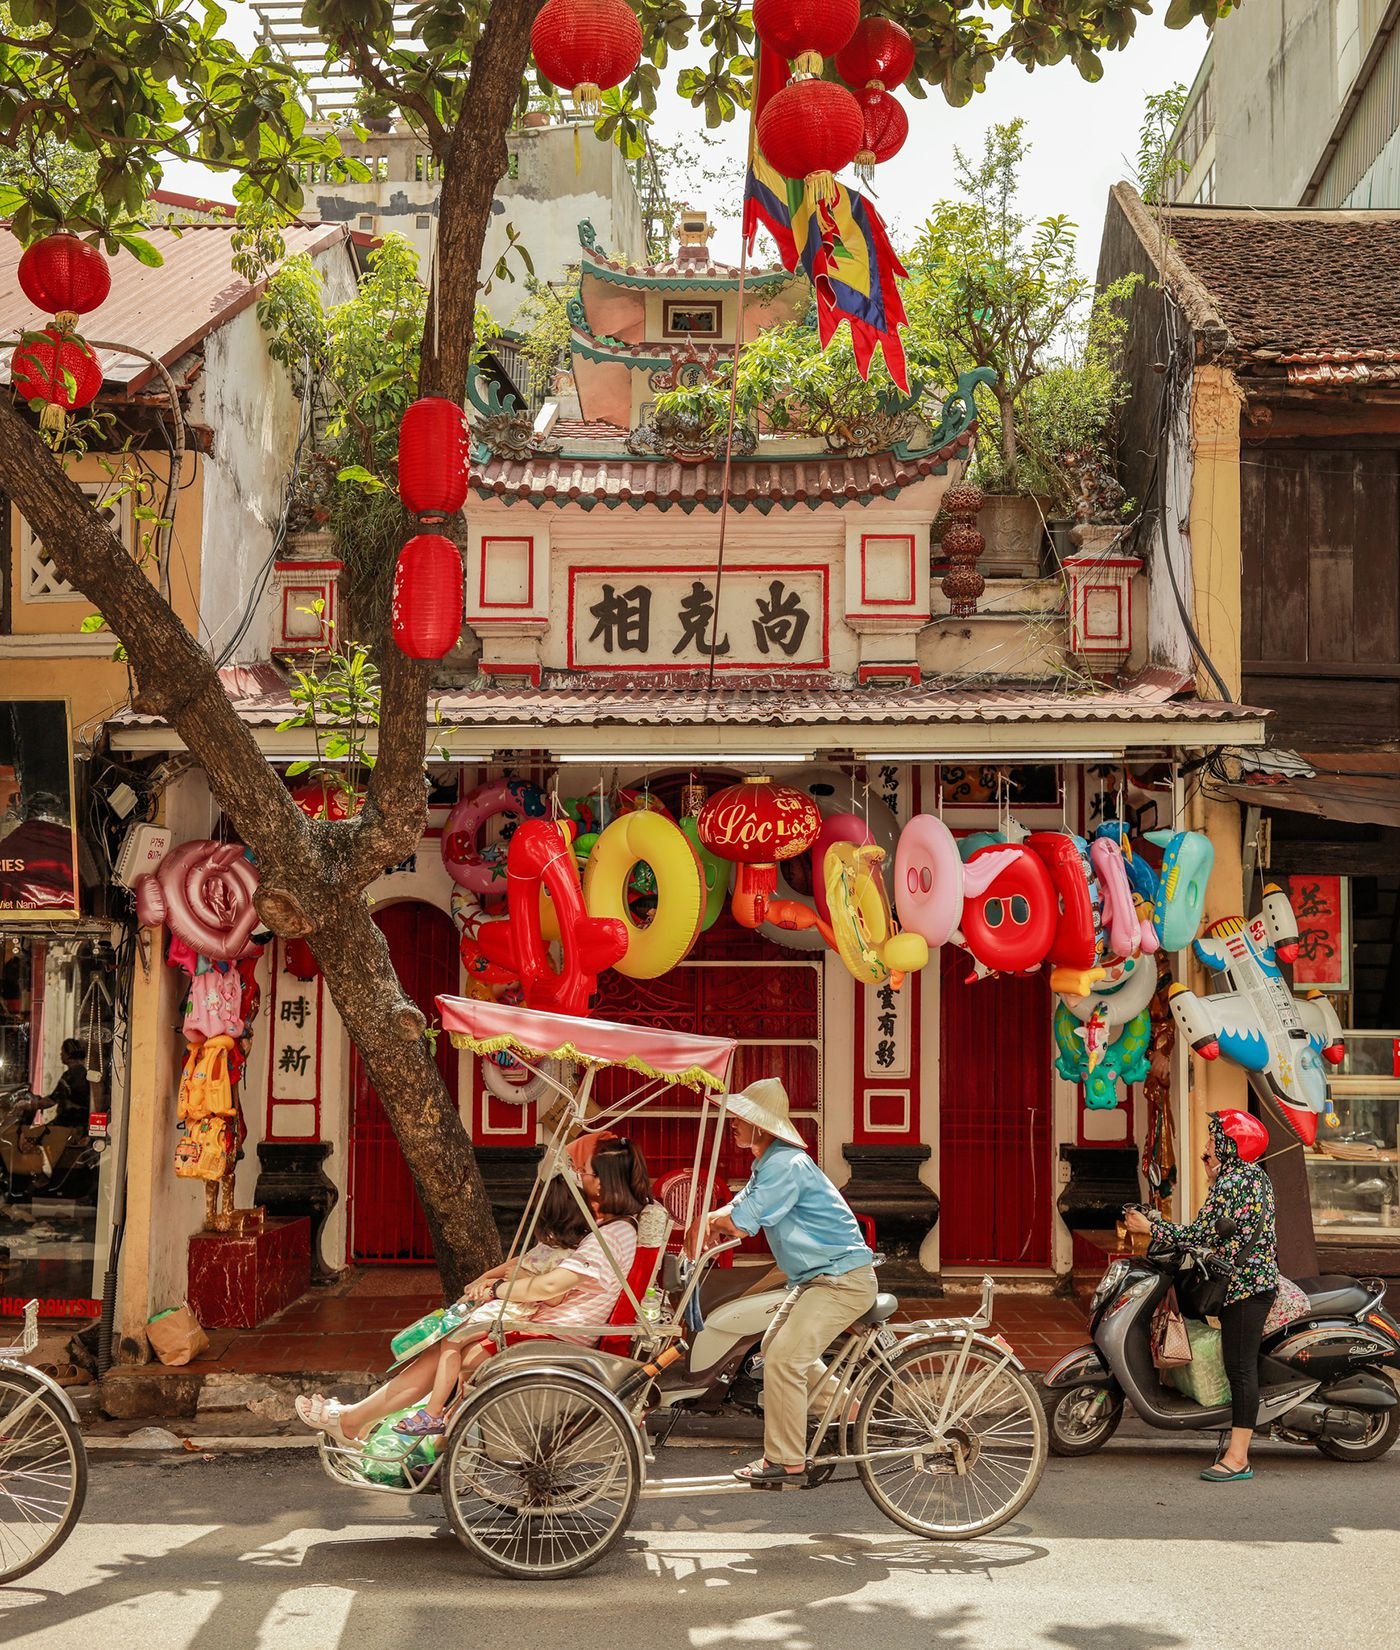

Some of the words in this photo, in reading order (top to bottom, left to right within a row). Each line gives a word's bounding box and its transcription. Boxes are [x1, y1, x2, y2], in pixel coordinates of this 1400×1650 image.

[714, 804, 774, 850] Lộc
[0, 859, 25, 872] IES
[16, 900, 37, 909] Nam
